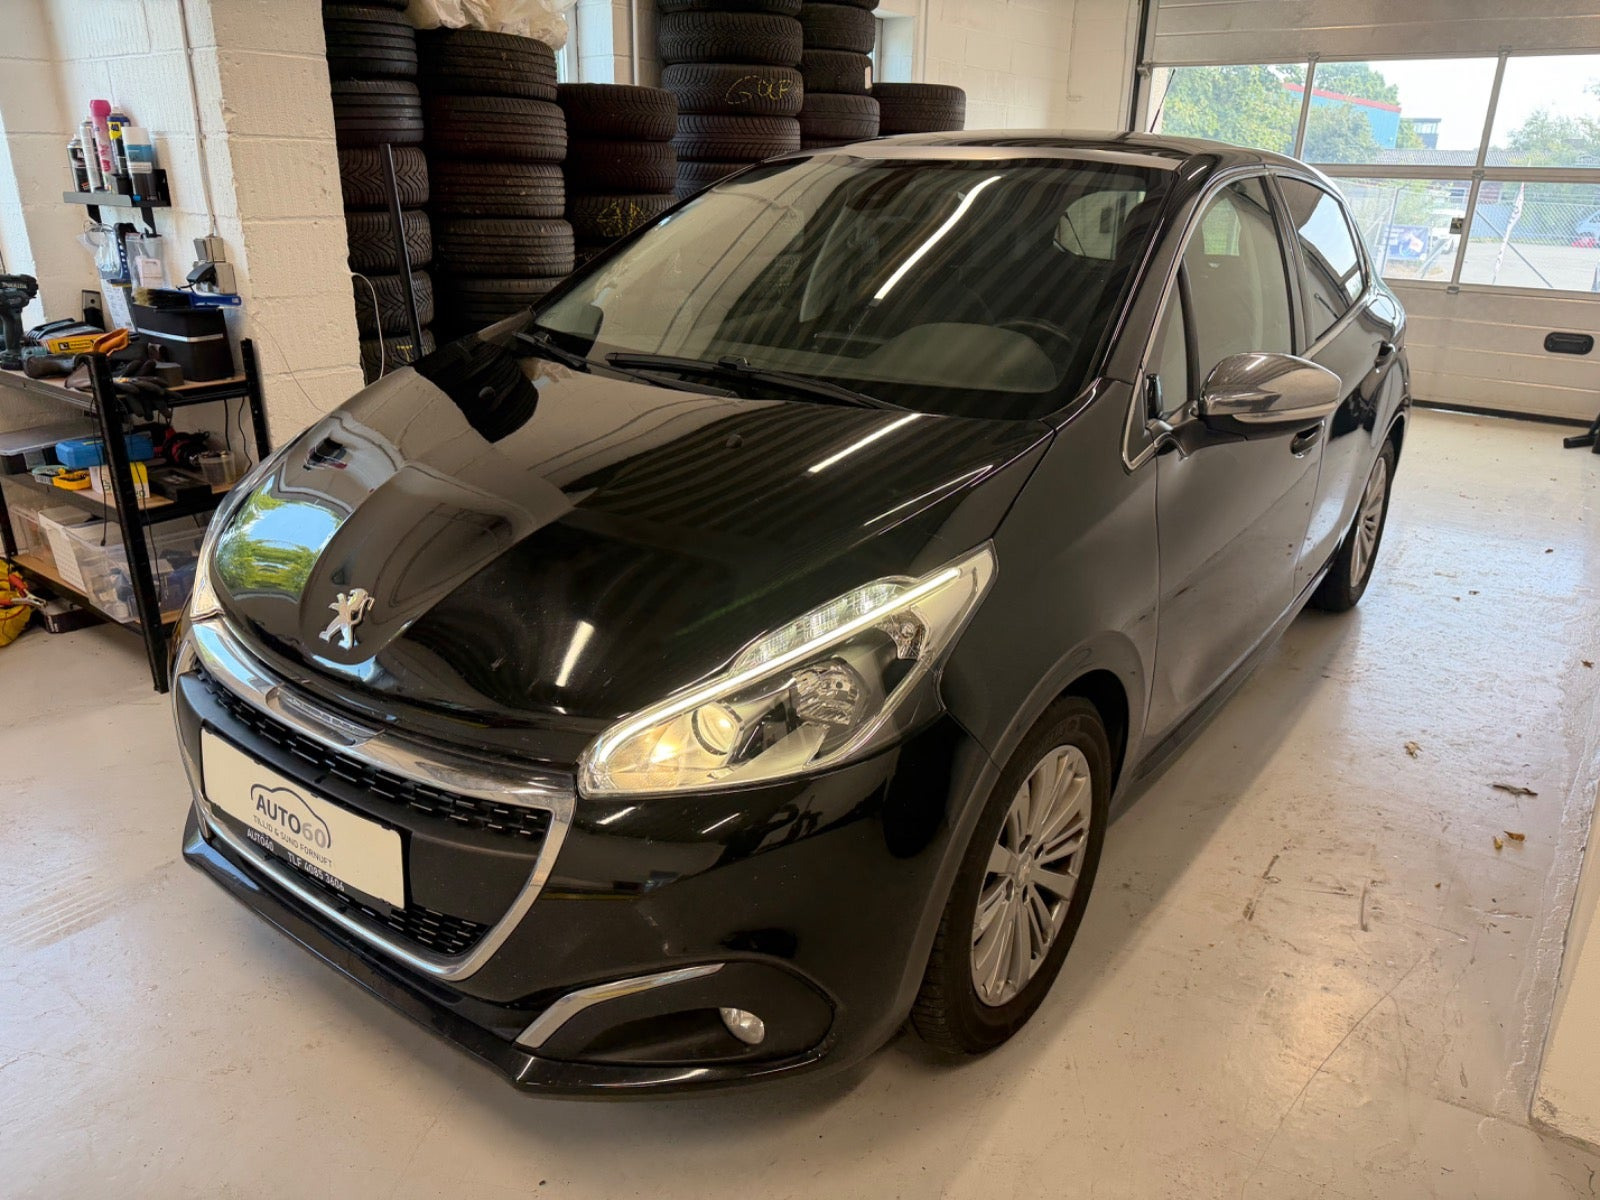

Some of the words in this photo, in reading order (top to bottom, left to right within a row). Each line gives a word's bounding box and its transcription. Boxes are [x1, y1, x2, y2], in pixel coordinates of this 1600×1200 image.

[253, 815, 272, 833] TILLID
[274, 828, 280, 836] &
[280, 832, 299, 849] SUND
[300, 843, 332, 867] FORNUFT
[256, 794, 326, 848] AUTO60
[247, 828, 274, 851] AUTO60
[287, 851, 302, 867] TLF
